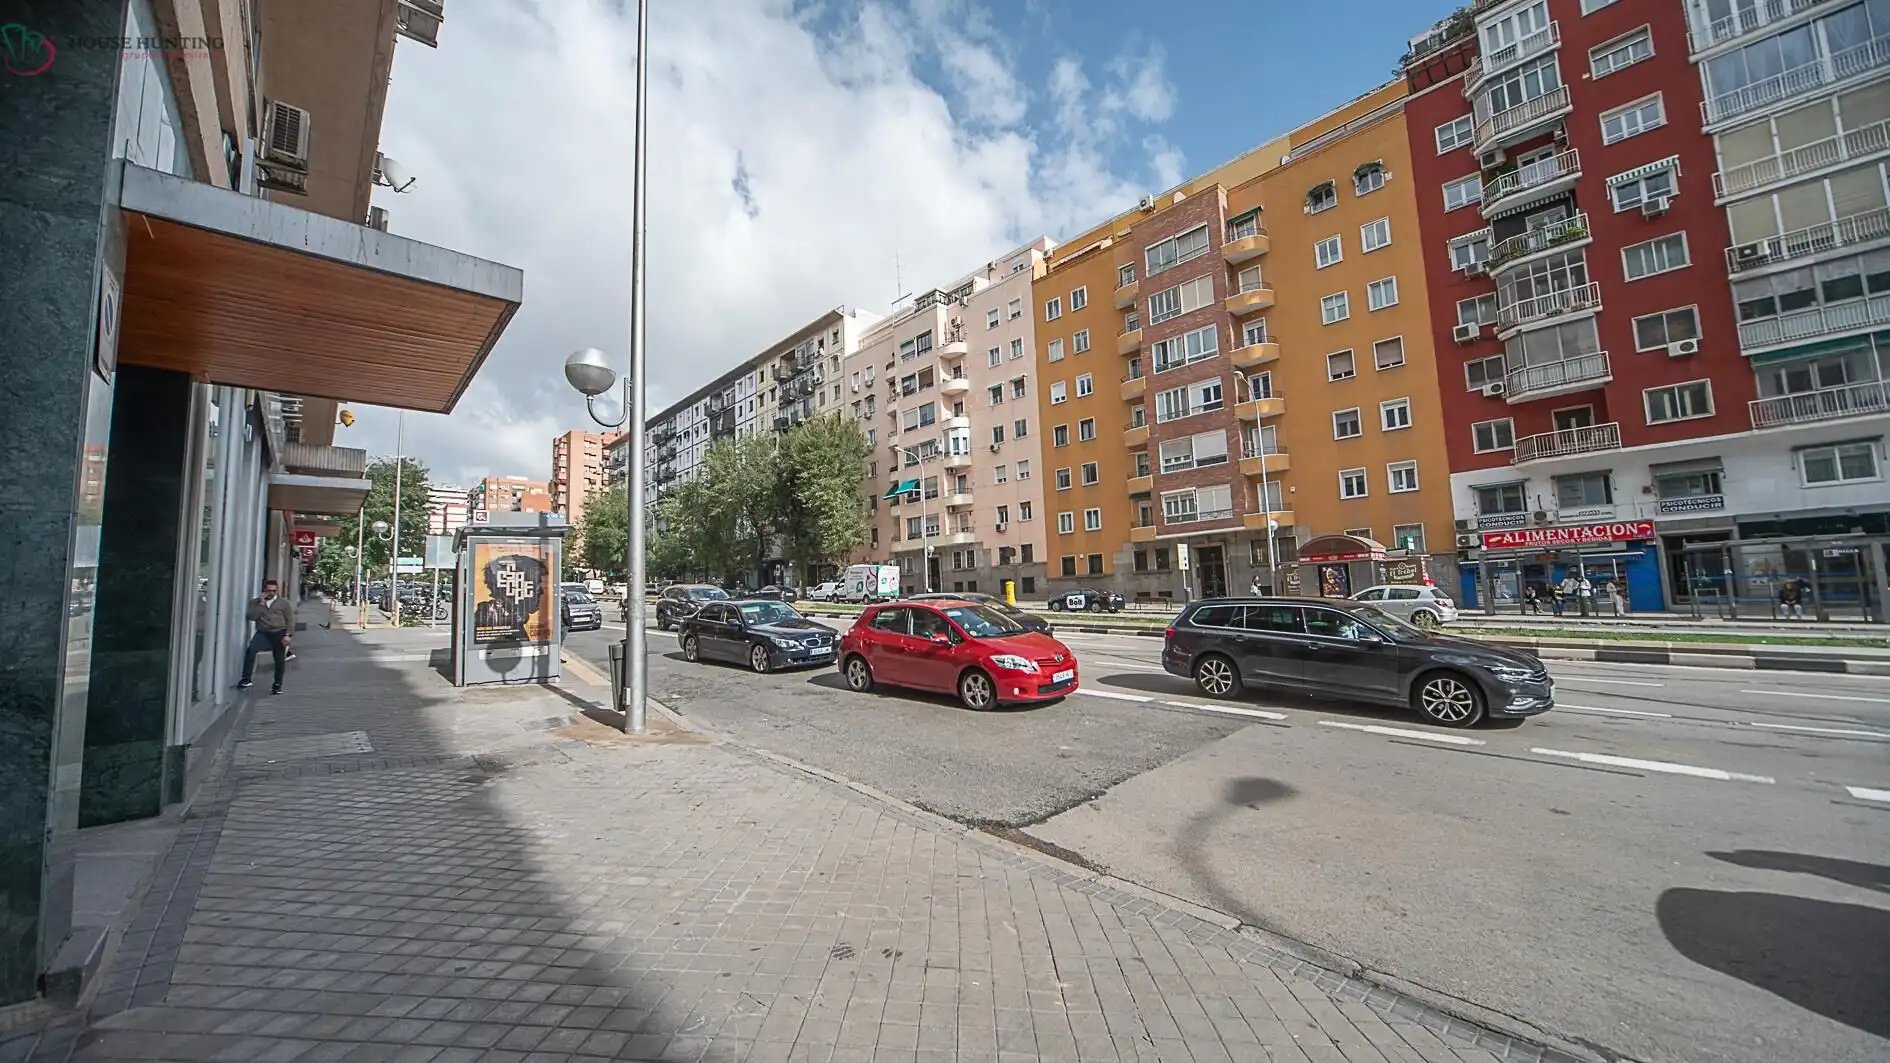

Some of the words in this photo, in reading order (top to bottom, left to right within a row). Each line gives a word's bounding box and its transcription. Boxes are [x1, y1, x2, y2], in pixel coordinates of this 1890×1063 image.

[1662, 503, 1721, 512] CONDUCIR
[1479, 520, 1525, 528] CONDUCIR
[1502, 522, 1640, 544] ALIMENTACION
